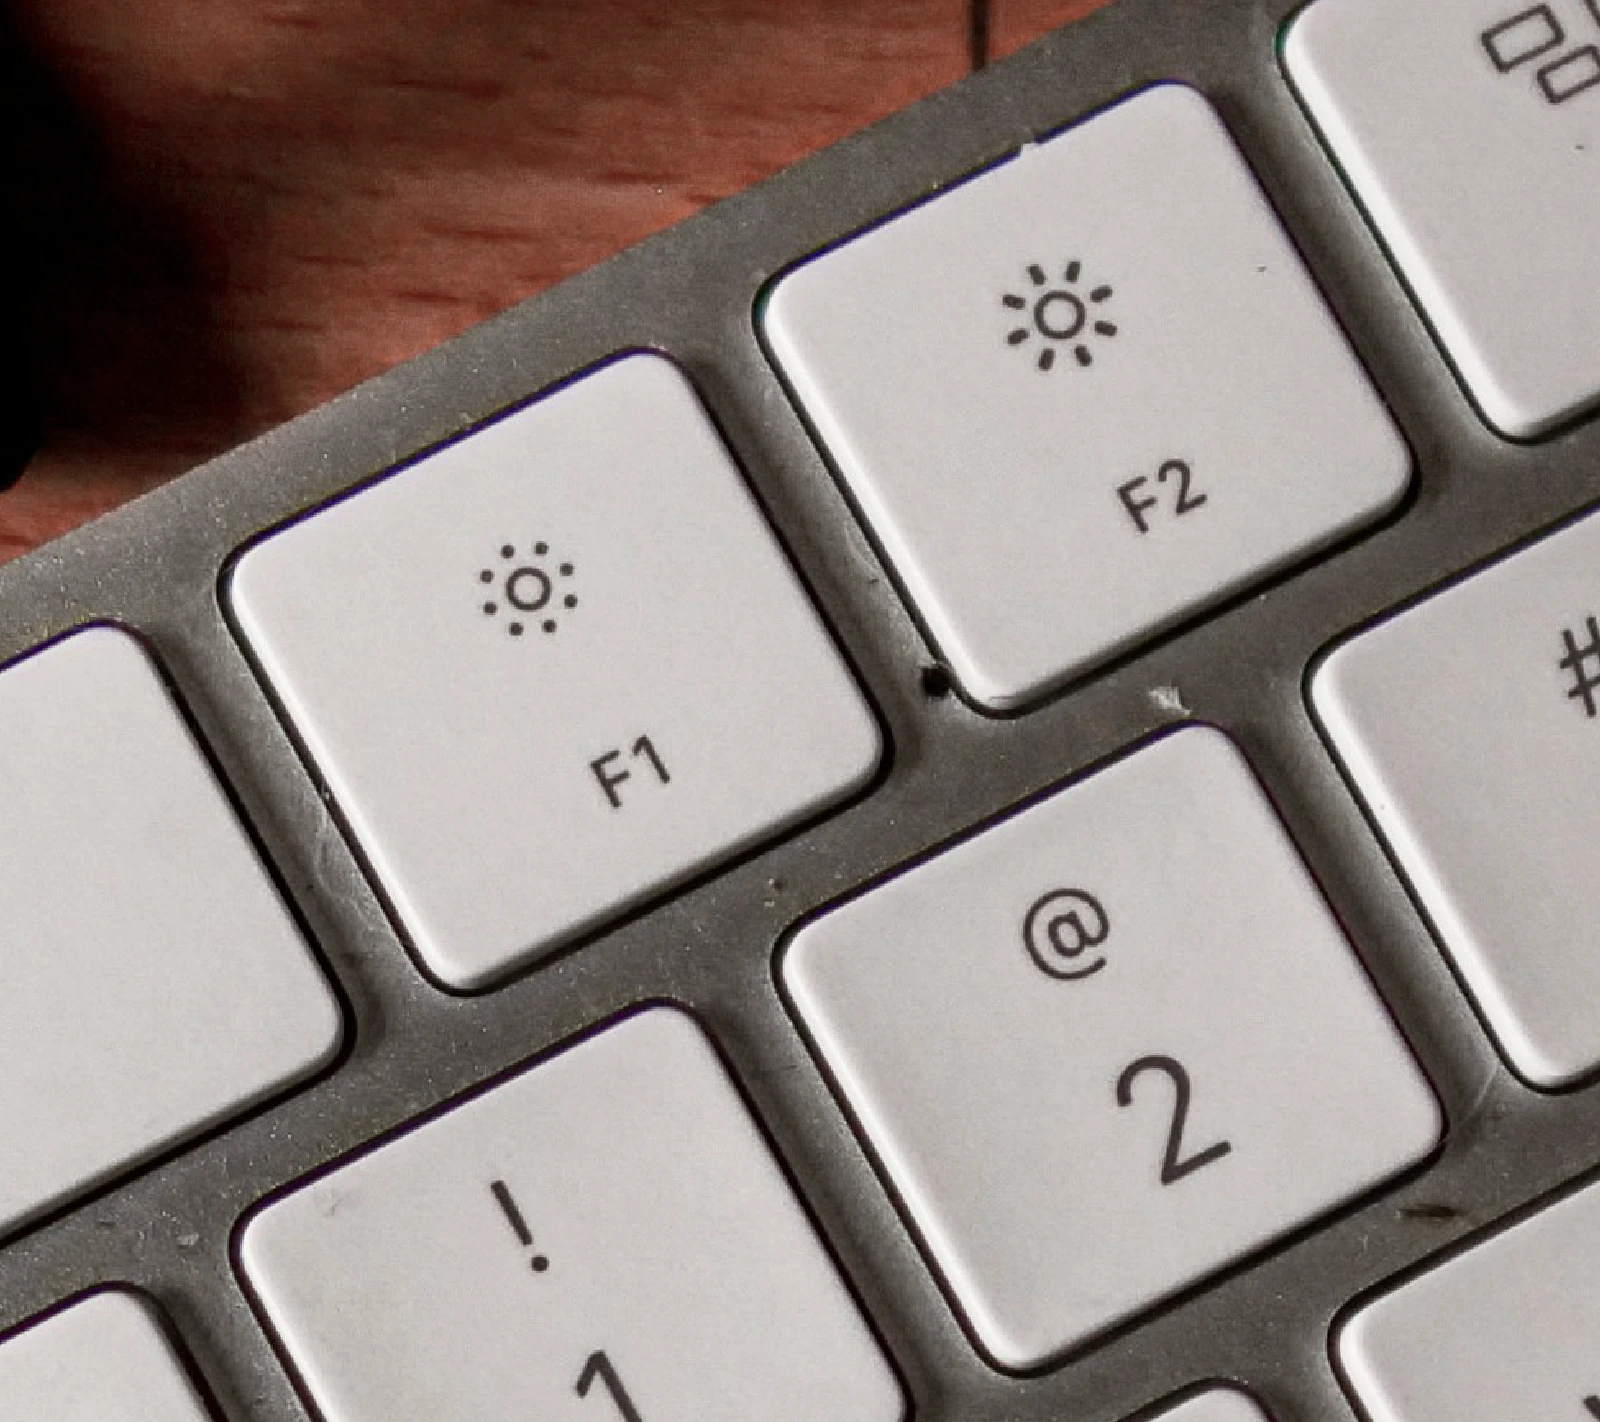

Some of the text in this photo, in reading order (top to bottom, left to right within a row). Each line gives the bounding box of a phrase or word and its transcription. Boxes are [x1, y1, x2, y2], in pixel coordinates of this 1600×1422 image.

[1117, 459, 1207, 533] F2
[590, 735, 670, 809] F1
[1023, 888, 1110, 981] @
[1115, 1055, 1231, 1186] 2
[490, 1180, 549, 1273] !
